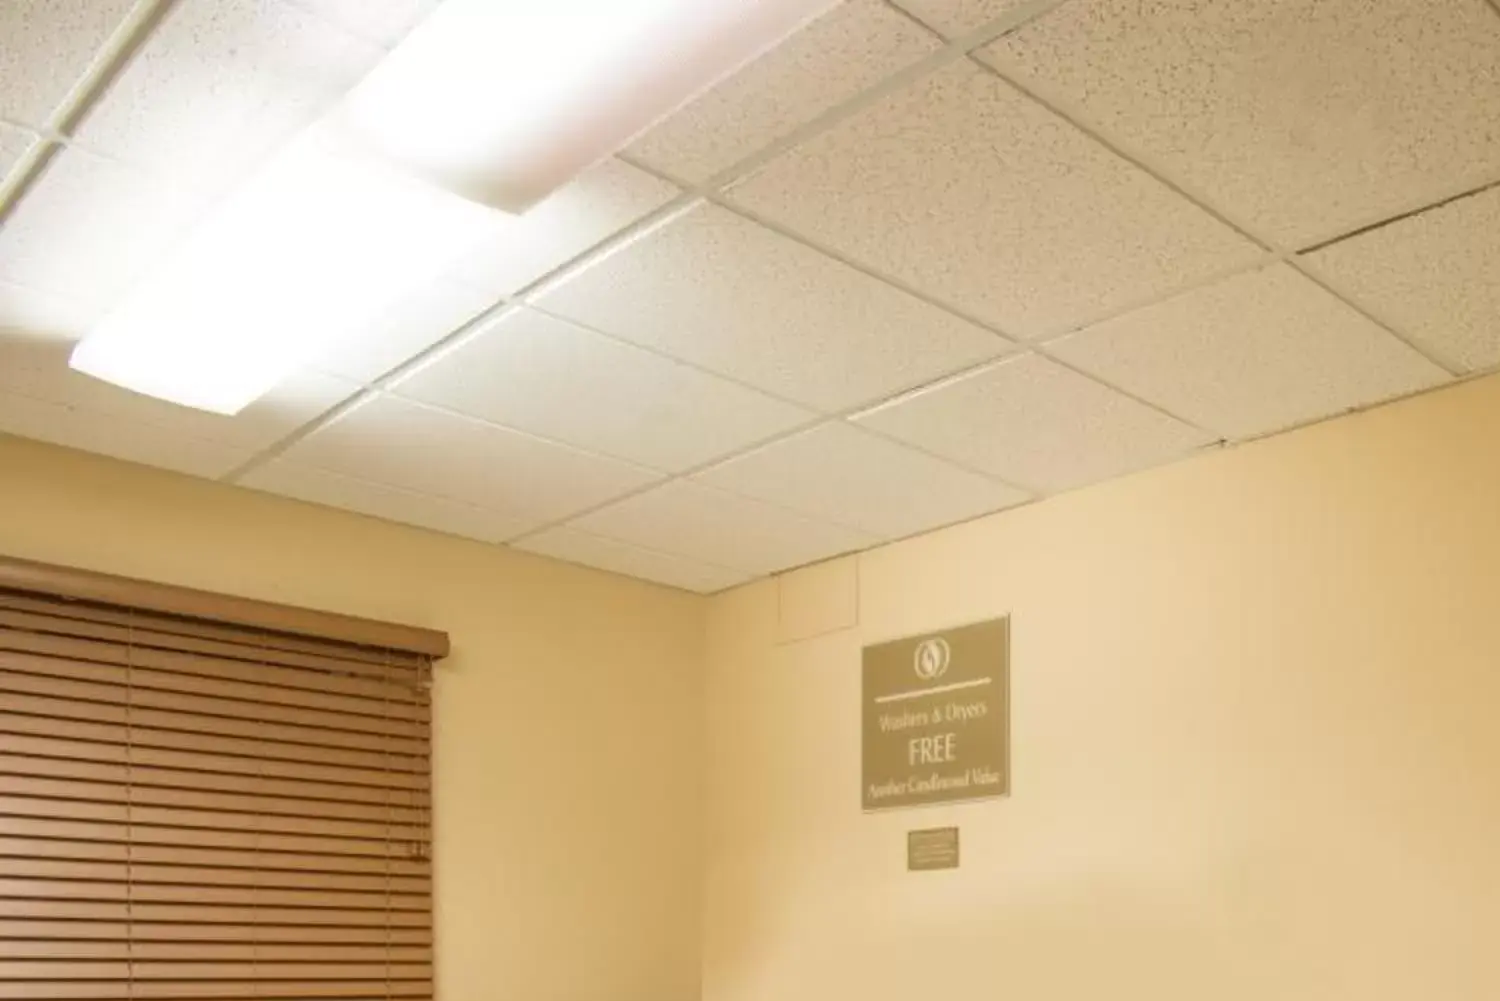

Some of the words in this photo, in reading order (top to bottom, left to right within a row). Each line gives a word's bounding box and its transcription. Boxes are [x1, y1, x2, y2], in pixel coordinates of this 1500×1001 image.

[879, 709, 928, 733] Washers
[932, 706, 942, 724] &
[945, 701, 988, 726] Dryers
[908, 732, 957, 766] FREE
